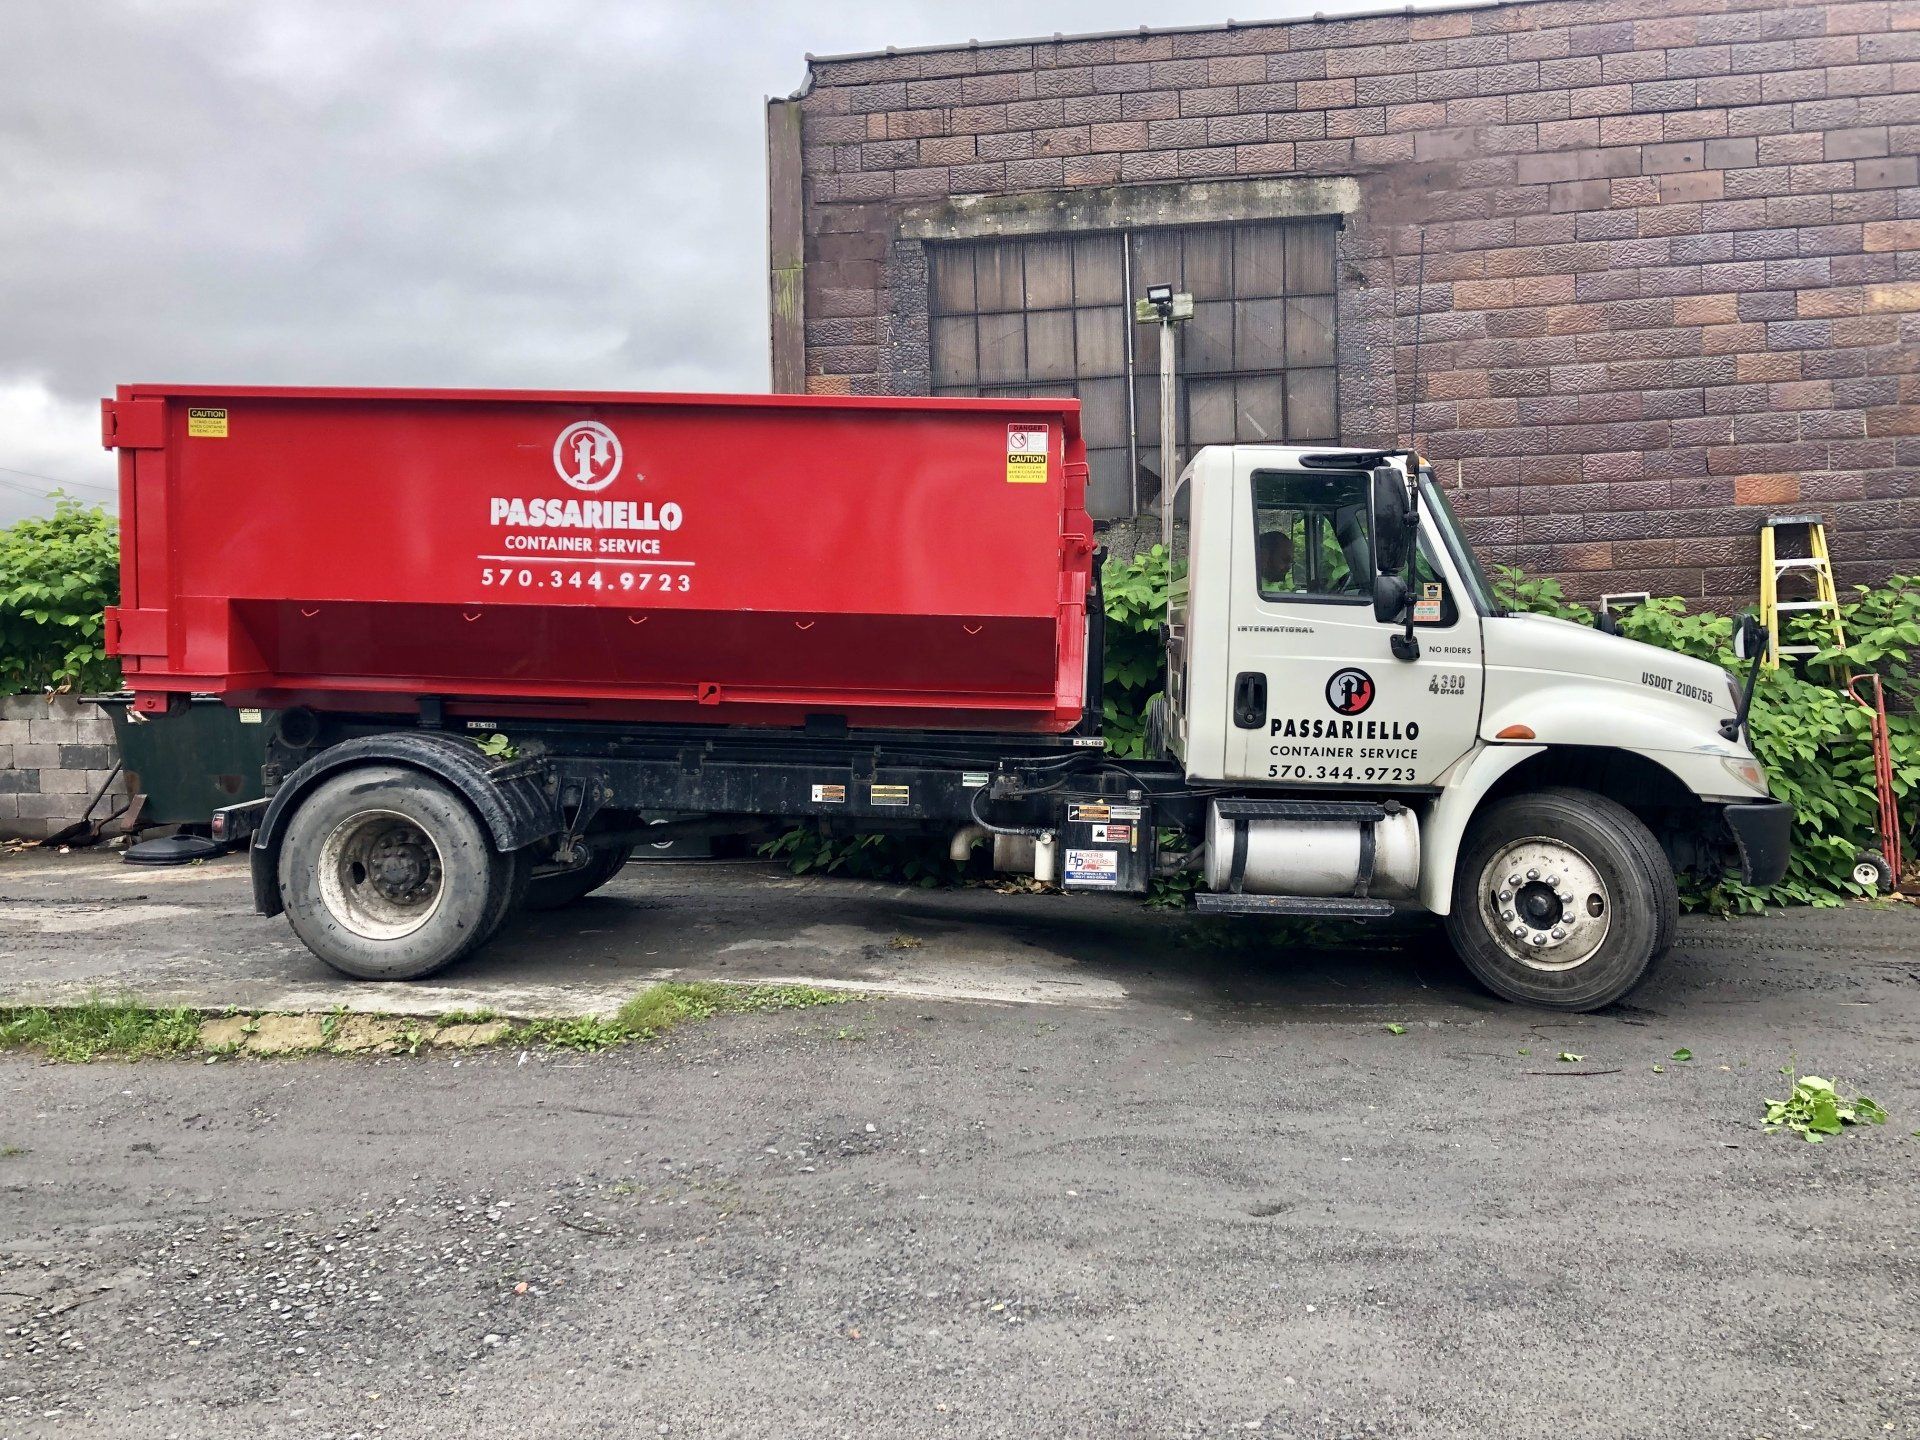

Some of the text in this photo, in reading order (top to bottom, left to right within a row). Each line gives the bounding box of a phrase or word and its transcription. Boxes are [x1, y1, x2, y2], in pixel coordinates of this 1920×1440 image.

[1010, 455, 1044, 463] CAUTION
[490, 497, 683, 531] PASSARIELLO
[505, 535, 660, 554] CONTAINER SERVICE
[481, 568, 690, 592] 570.344.9723
[1237, 625, 1315, 633] INTERNATIONAL
[1429, 674, 1465, 695] 4300
[1641, 671, 1713, 704] USDOT 2106755
[1270, 718, 1419, 741] PASSARIELLO
[1270, 745, 1418, 759] CONTAINER SERVICE
[1268, 764, 1416, 781] 570.344.9723
